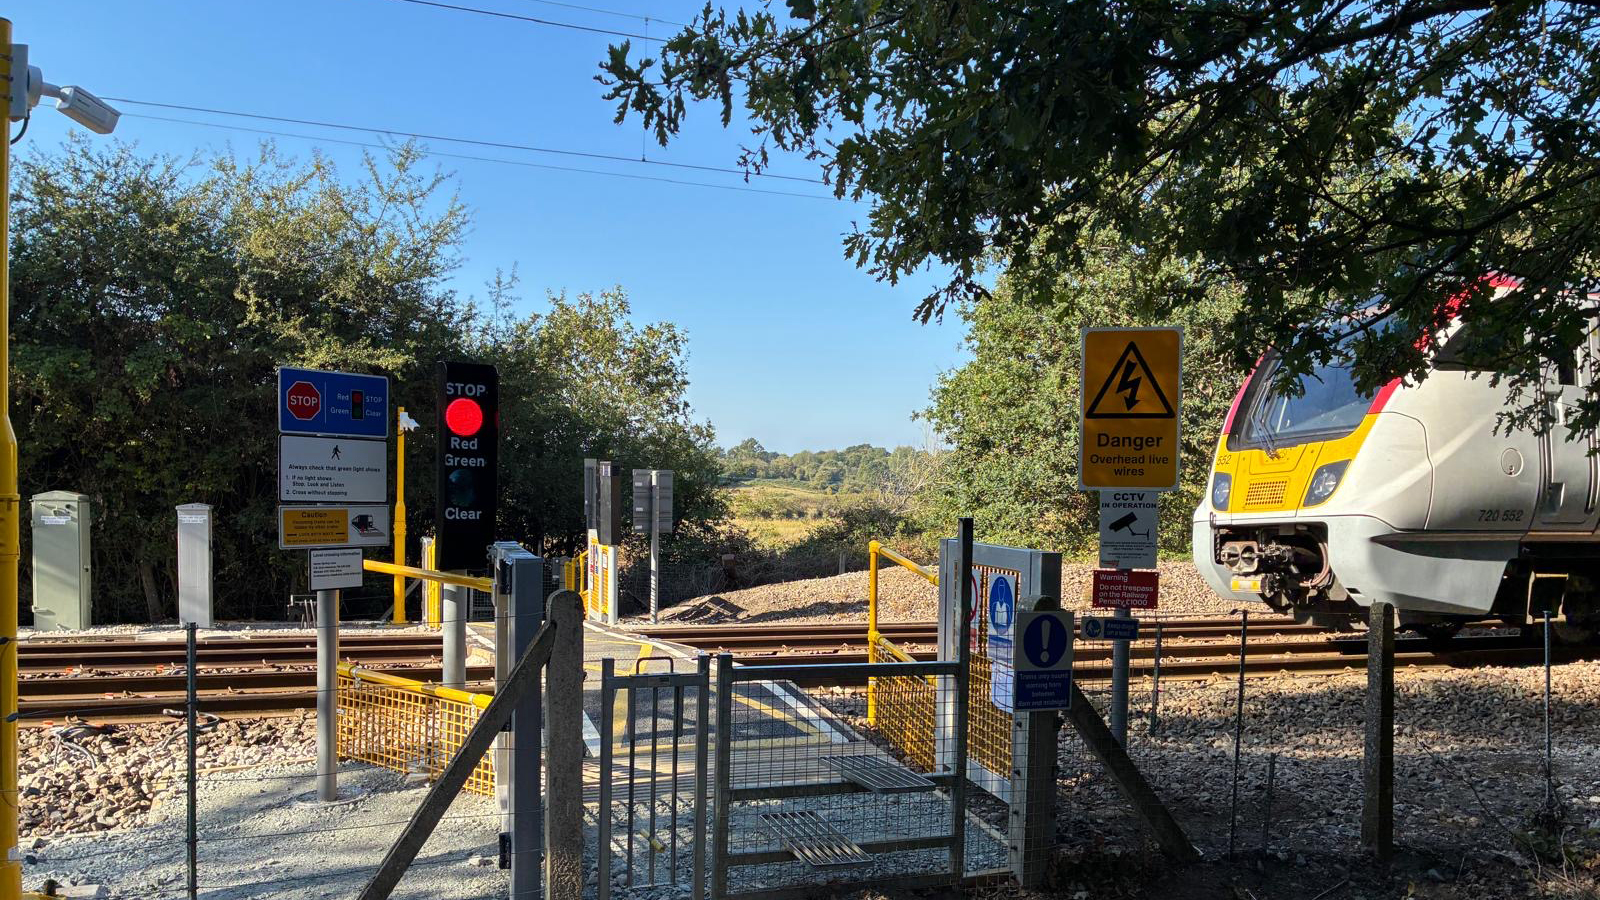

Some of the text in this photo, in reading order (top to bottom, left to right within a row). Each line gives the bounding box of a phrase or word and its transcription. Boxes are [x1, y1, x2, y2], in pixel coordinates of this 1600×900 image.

[446, 382, 486, 397] STOP
[290, 395, 318, 407] STOP
[337, 393, 382, 403] Red STOP
[330, 406, 381, 417] Green Clear
[450, 436, 478, 450] Red
[1097, 433, 1163, 451] Danger
[445, 453, 485, 467] Green
[1090, 454, 1169, 464] Overhead live
[1216, 454, 1232, 466] 552
[1114, 466, 1145, 476] wires
[1113, 492, 1146, 501] CCTV
[445, 507, 482, 520] Clear
[1478, 509, 1524, 522] 720 552
[1099, 574, 1128, 582] Warning
[1098, 598, 1125, 606] Penalty
